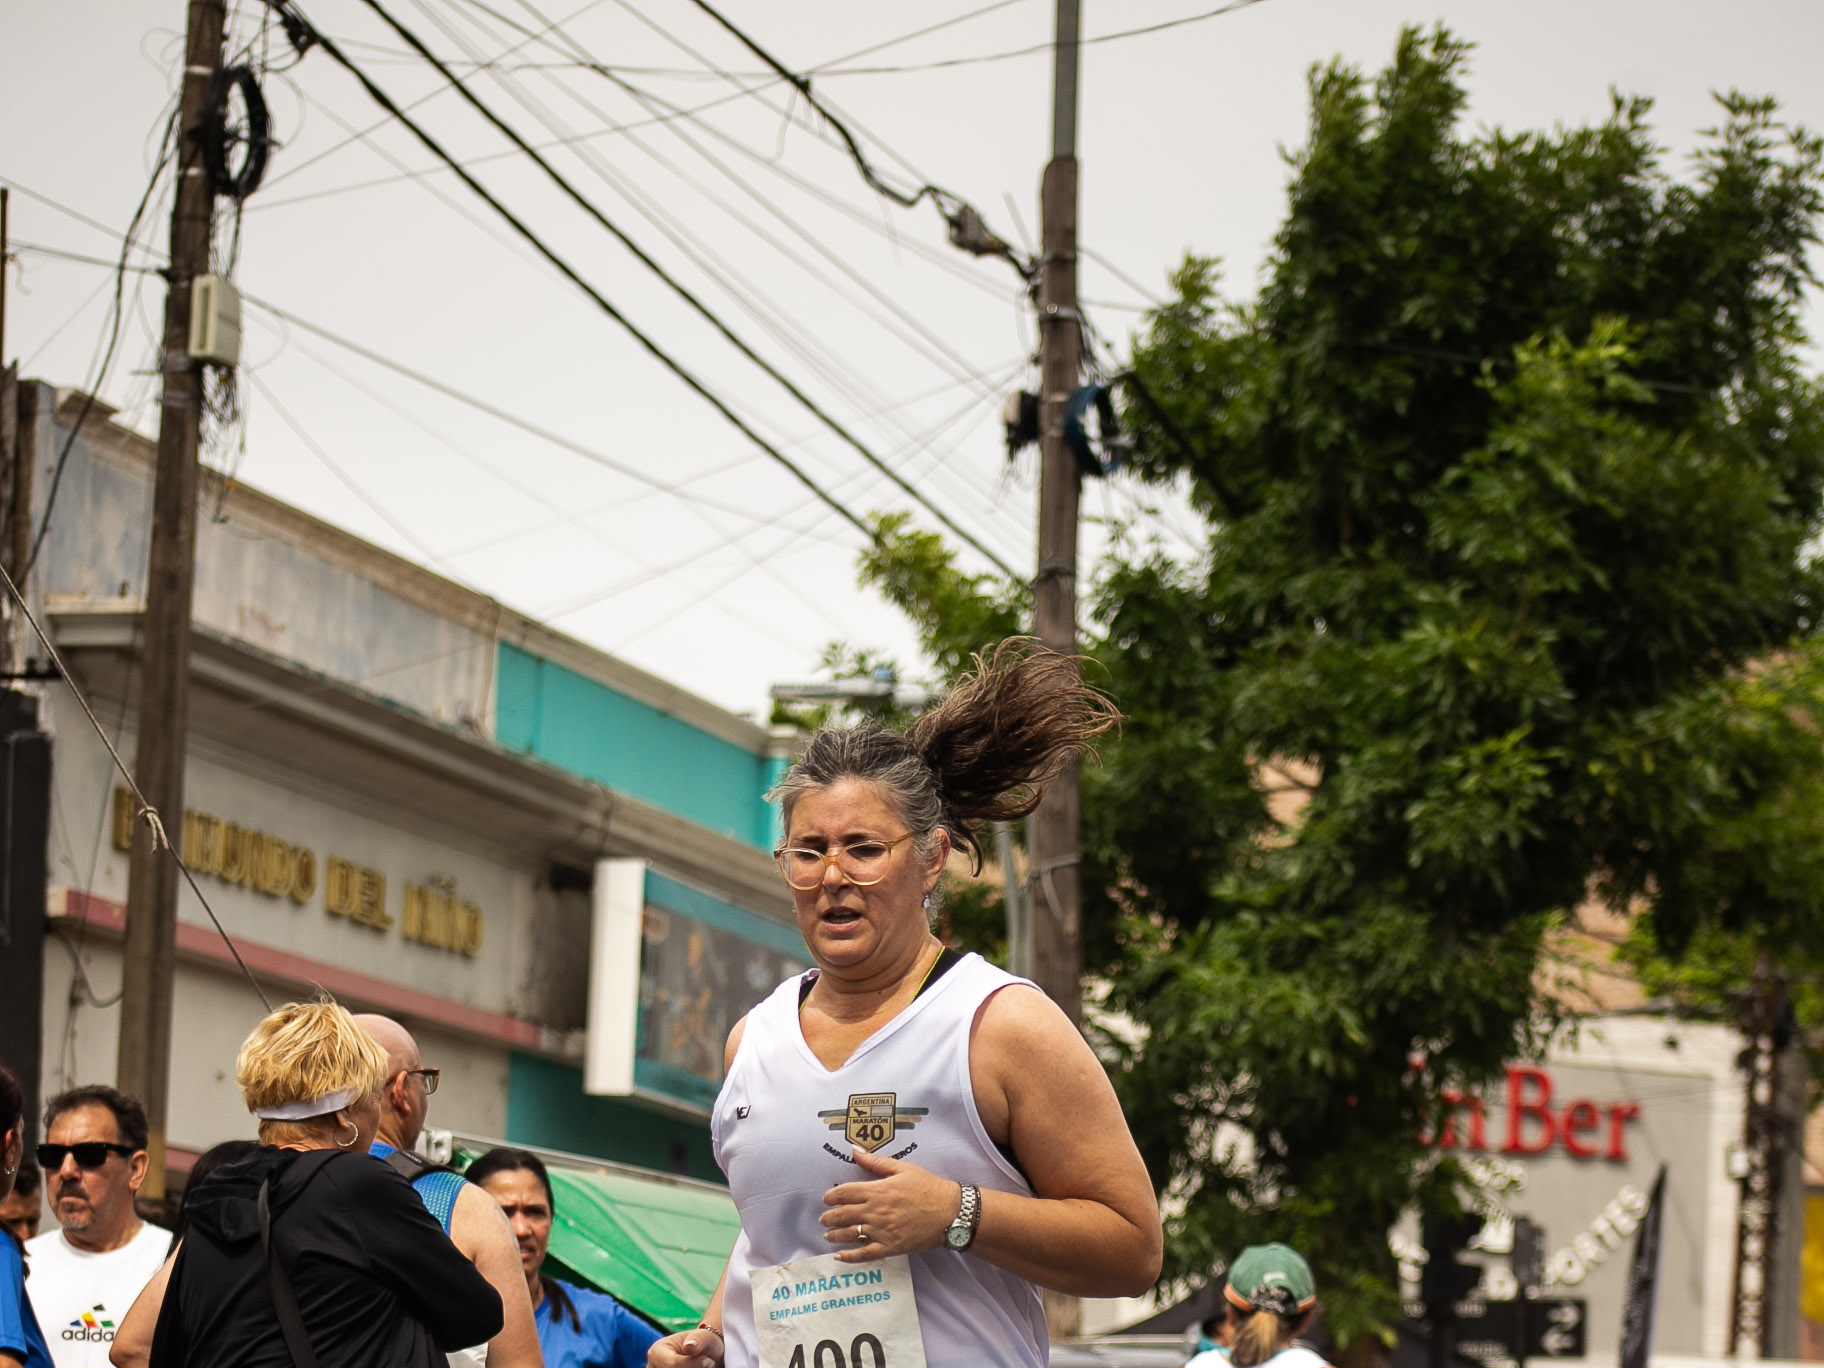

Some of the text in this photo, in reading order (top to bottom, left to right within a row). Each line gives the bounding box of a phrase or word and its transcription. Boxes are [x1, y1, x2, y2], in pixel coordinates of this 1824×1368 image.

[325, 857, 393, 931] DEL
[855, 1125, 884, 1142] 40
[771, 1269, 883, 1301] 40 MARATON
[769, 1291, 891, 1321] EMPALME GRANEROS
[62, 1328, 115, 1342] adida
